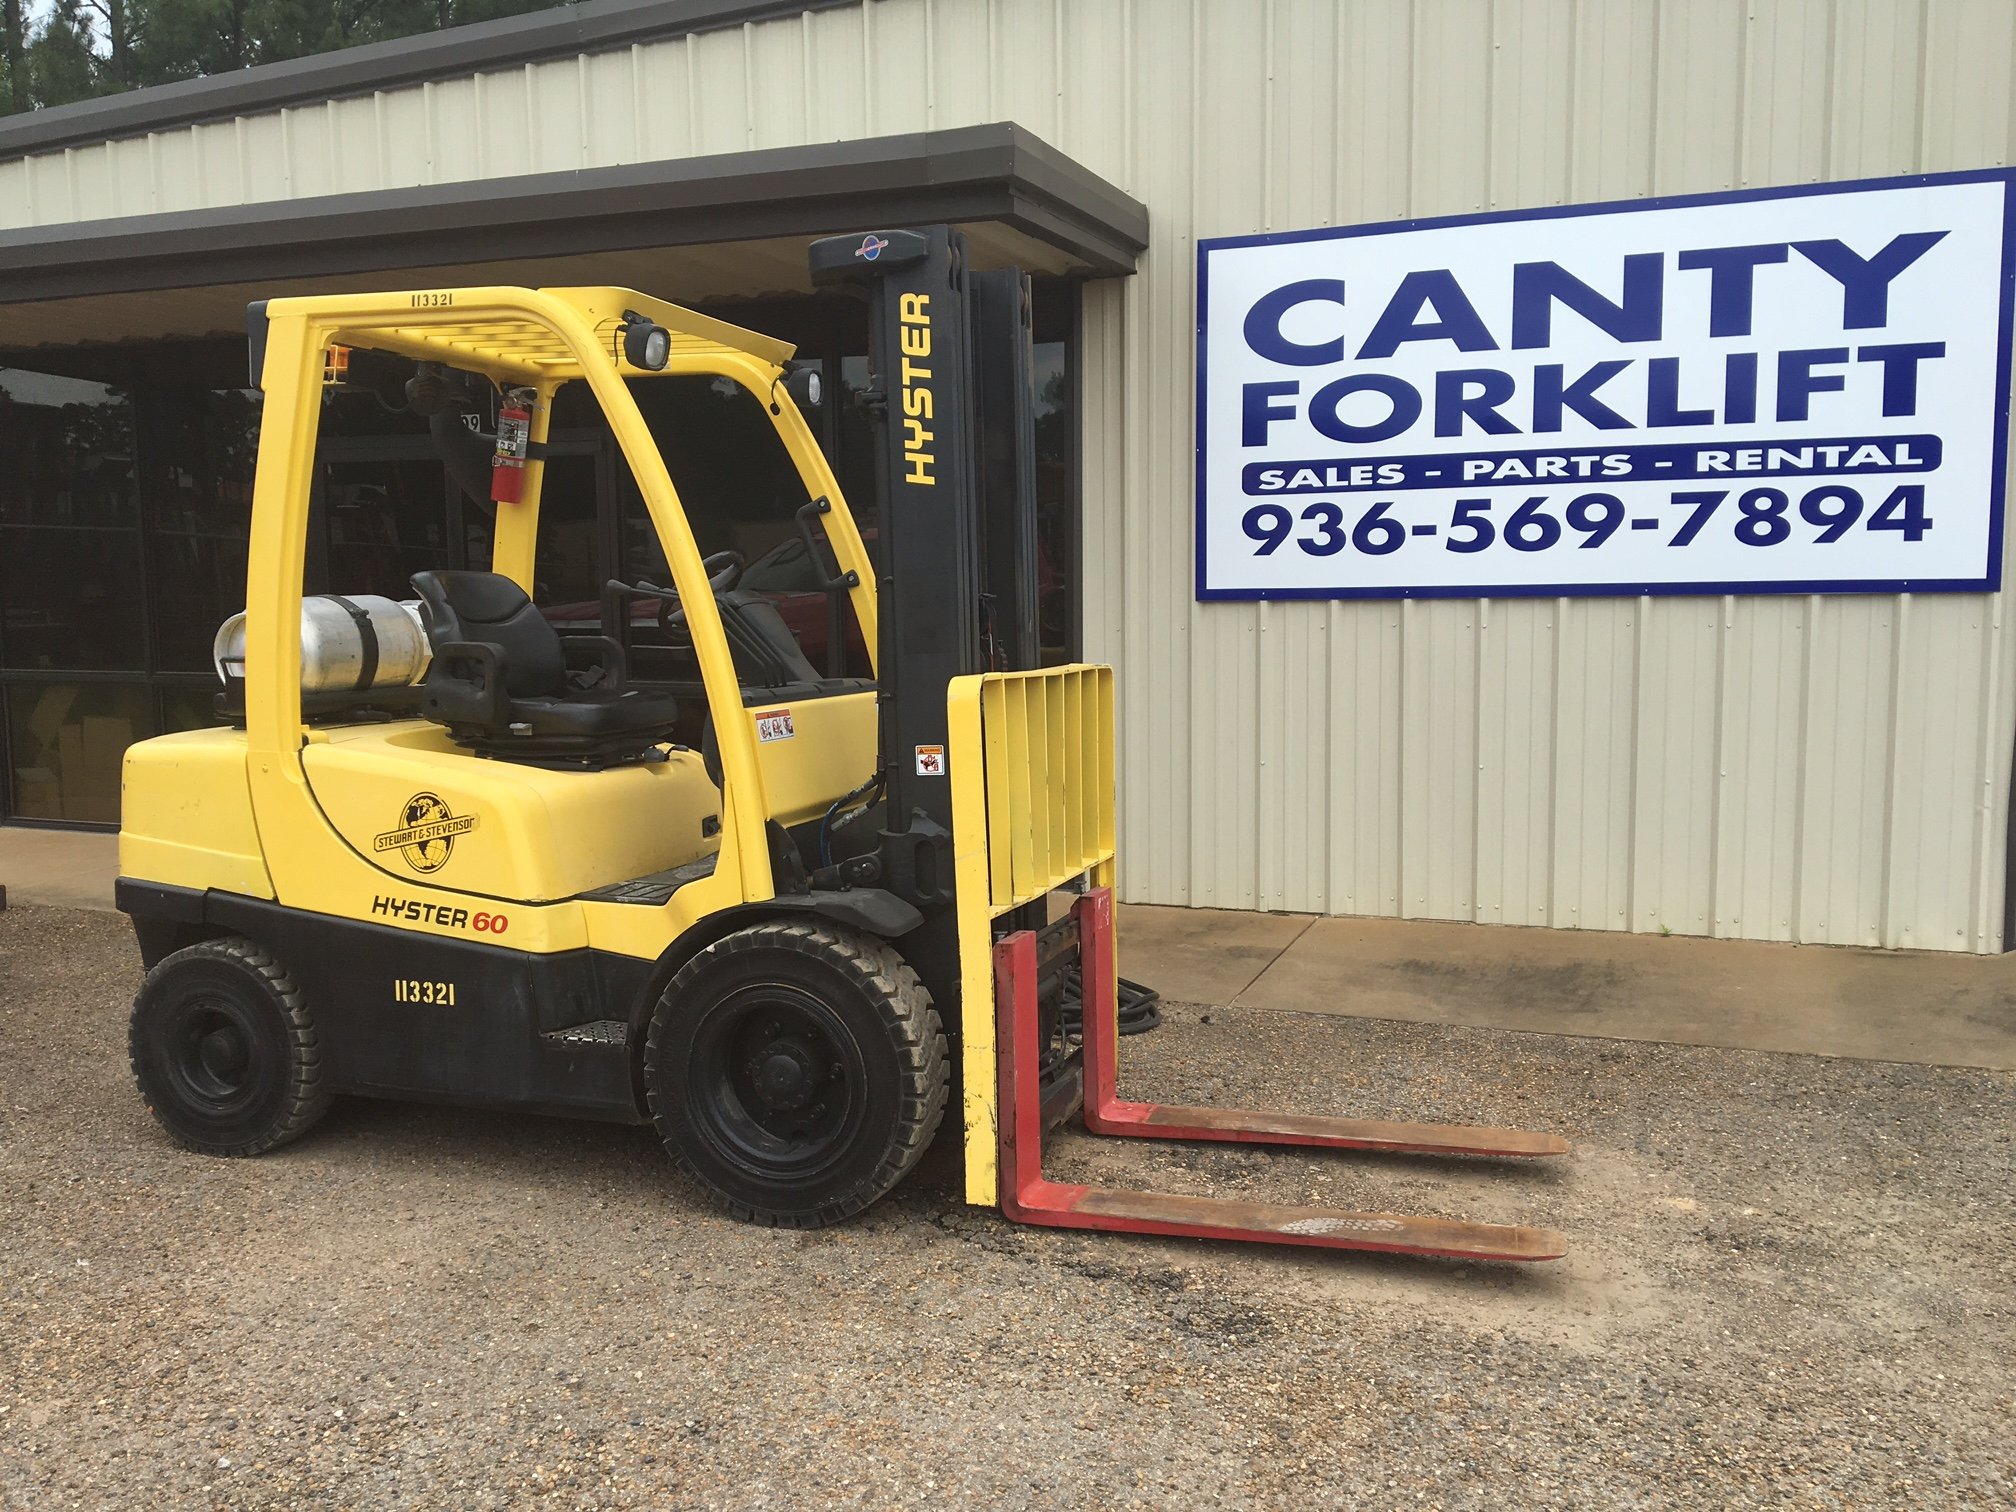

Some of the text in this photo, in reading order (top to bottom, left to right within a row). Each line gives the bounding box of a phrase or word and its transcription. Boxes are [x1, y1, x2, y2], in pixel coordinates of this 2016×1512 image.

[411, 292, 453, 307] 113321
[1243, 230, 1952, 367] CANTY
[900, 292, 936, 486] HYSTER
[1241, 341, 1946, 448] FORKLIFT
[1258, 463, 1405, 491] SALES
[1463, 454, 1634, 481] PARTS
[1696, 443, 1923, 473] RENTAL
[1241, 484, 1933, 557] 936-569-7894
[378, 829, 417, 848] STEWART
[418, 828, 425, 839] &
[371, 895, 509, 934] HYSTER 60
[394, 979, 455, 1006] 113321
